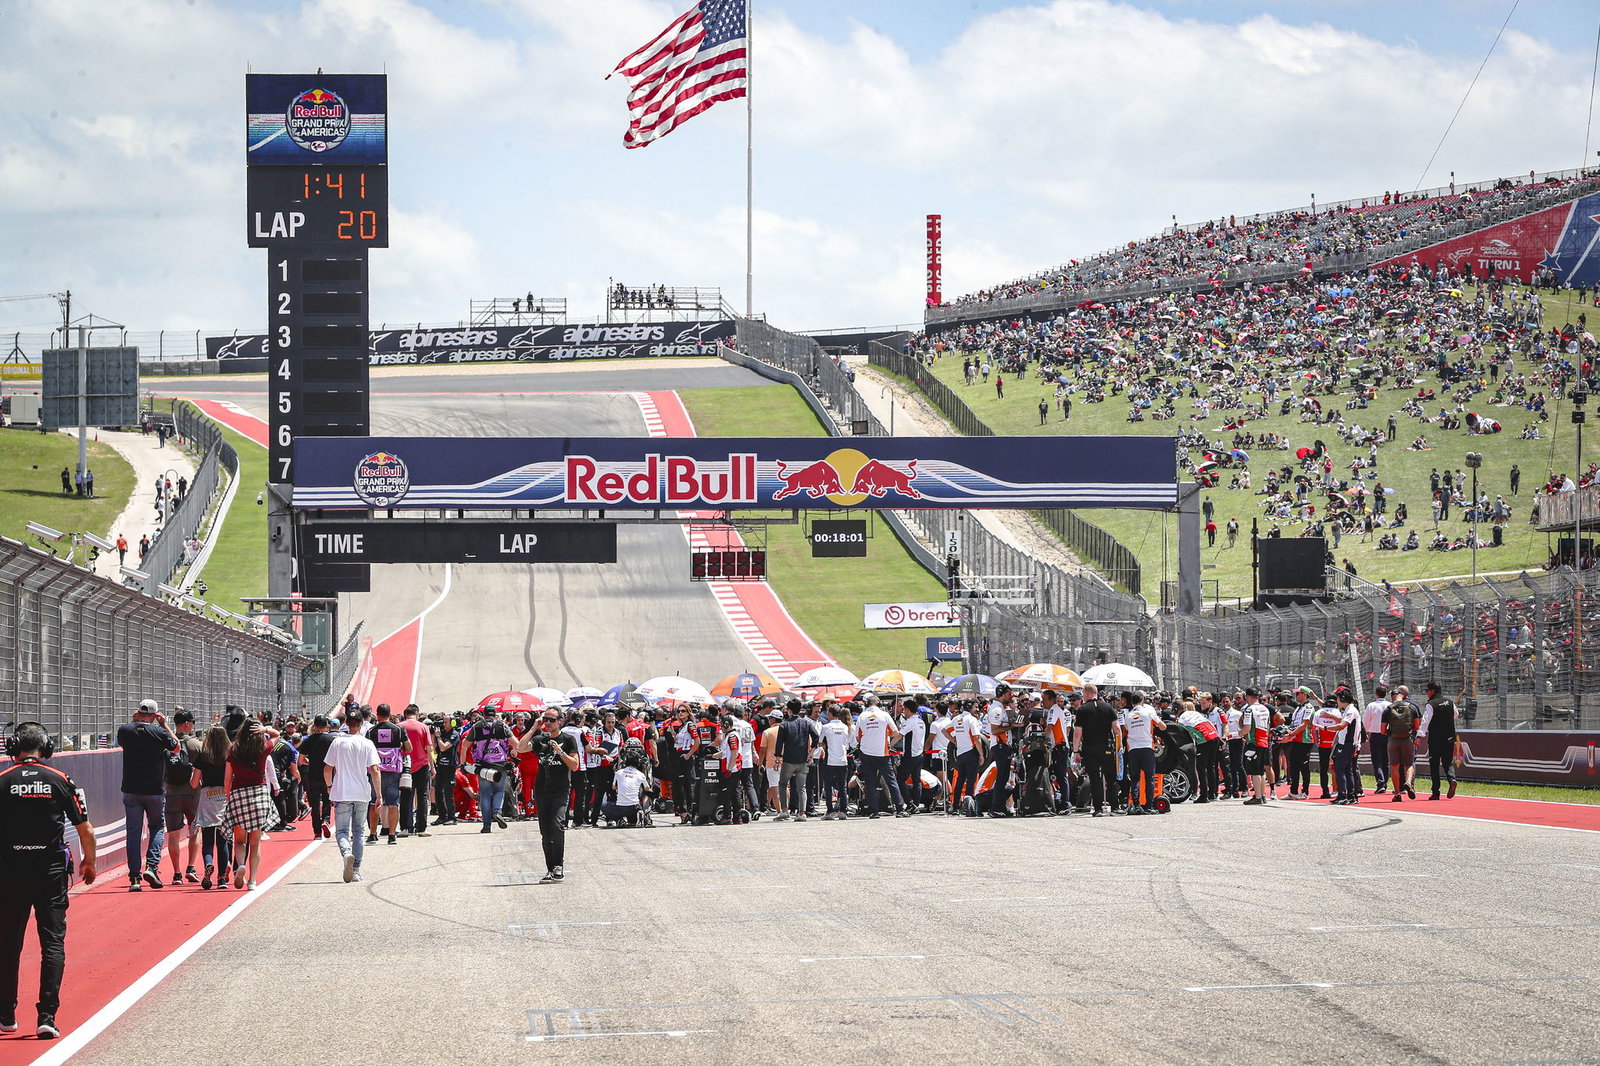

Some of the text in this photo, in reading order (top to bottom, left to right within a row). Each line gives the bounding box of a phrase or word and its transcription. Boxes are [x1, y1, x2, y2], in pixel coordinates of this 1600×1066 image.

[295, 105, 342, 117] Red Bull
[291, 119, 323, 128] GRAND
[300, 128, 345, 137] AMERICAS
[255, 211, 306, 238] LAP
[338, 210, 377, 239] 20
[278, 260, 288, 282] 1
[1514, 261, 1520, 270] 1
[278, 293, 291, 315] 2
[278, 325, 291, 348] 3
[400, 325, 498, 351] alpinestars
[563, 323, 664, 346] alpinestars
[549, 345, 616, 360] alpinestars
[278, 359, 291, 380] 4
[278, 392, 291, 413] 5
[278, 425, 291, 446] 6
[279, 458, 291, 479] 7
[362, 466, 402, 476] Red Bull
[564, 453, 758, 504] Red Bull
[359, 478, 385, 486] GRAND
[366, 485, 405, 493] AMERICAS
[315, 534, 364, 554] TIME
[500, 534, 538, 553] LAP
[814, 532, 864, 544] 00:18:01
[10, 781, 52, 796] aprilia
